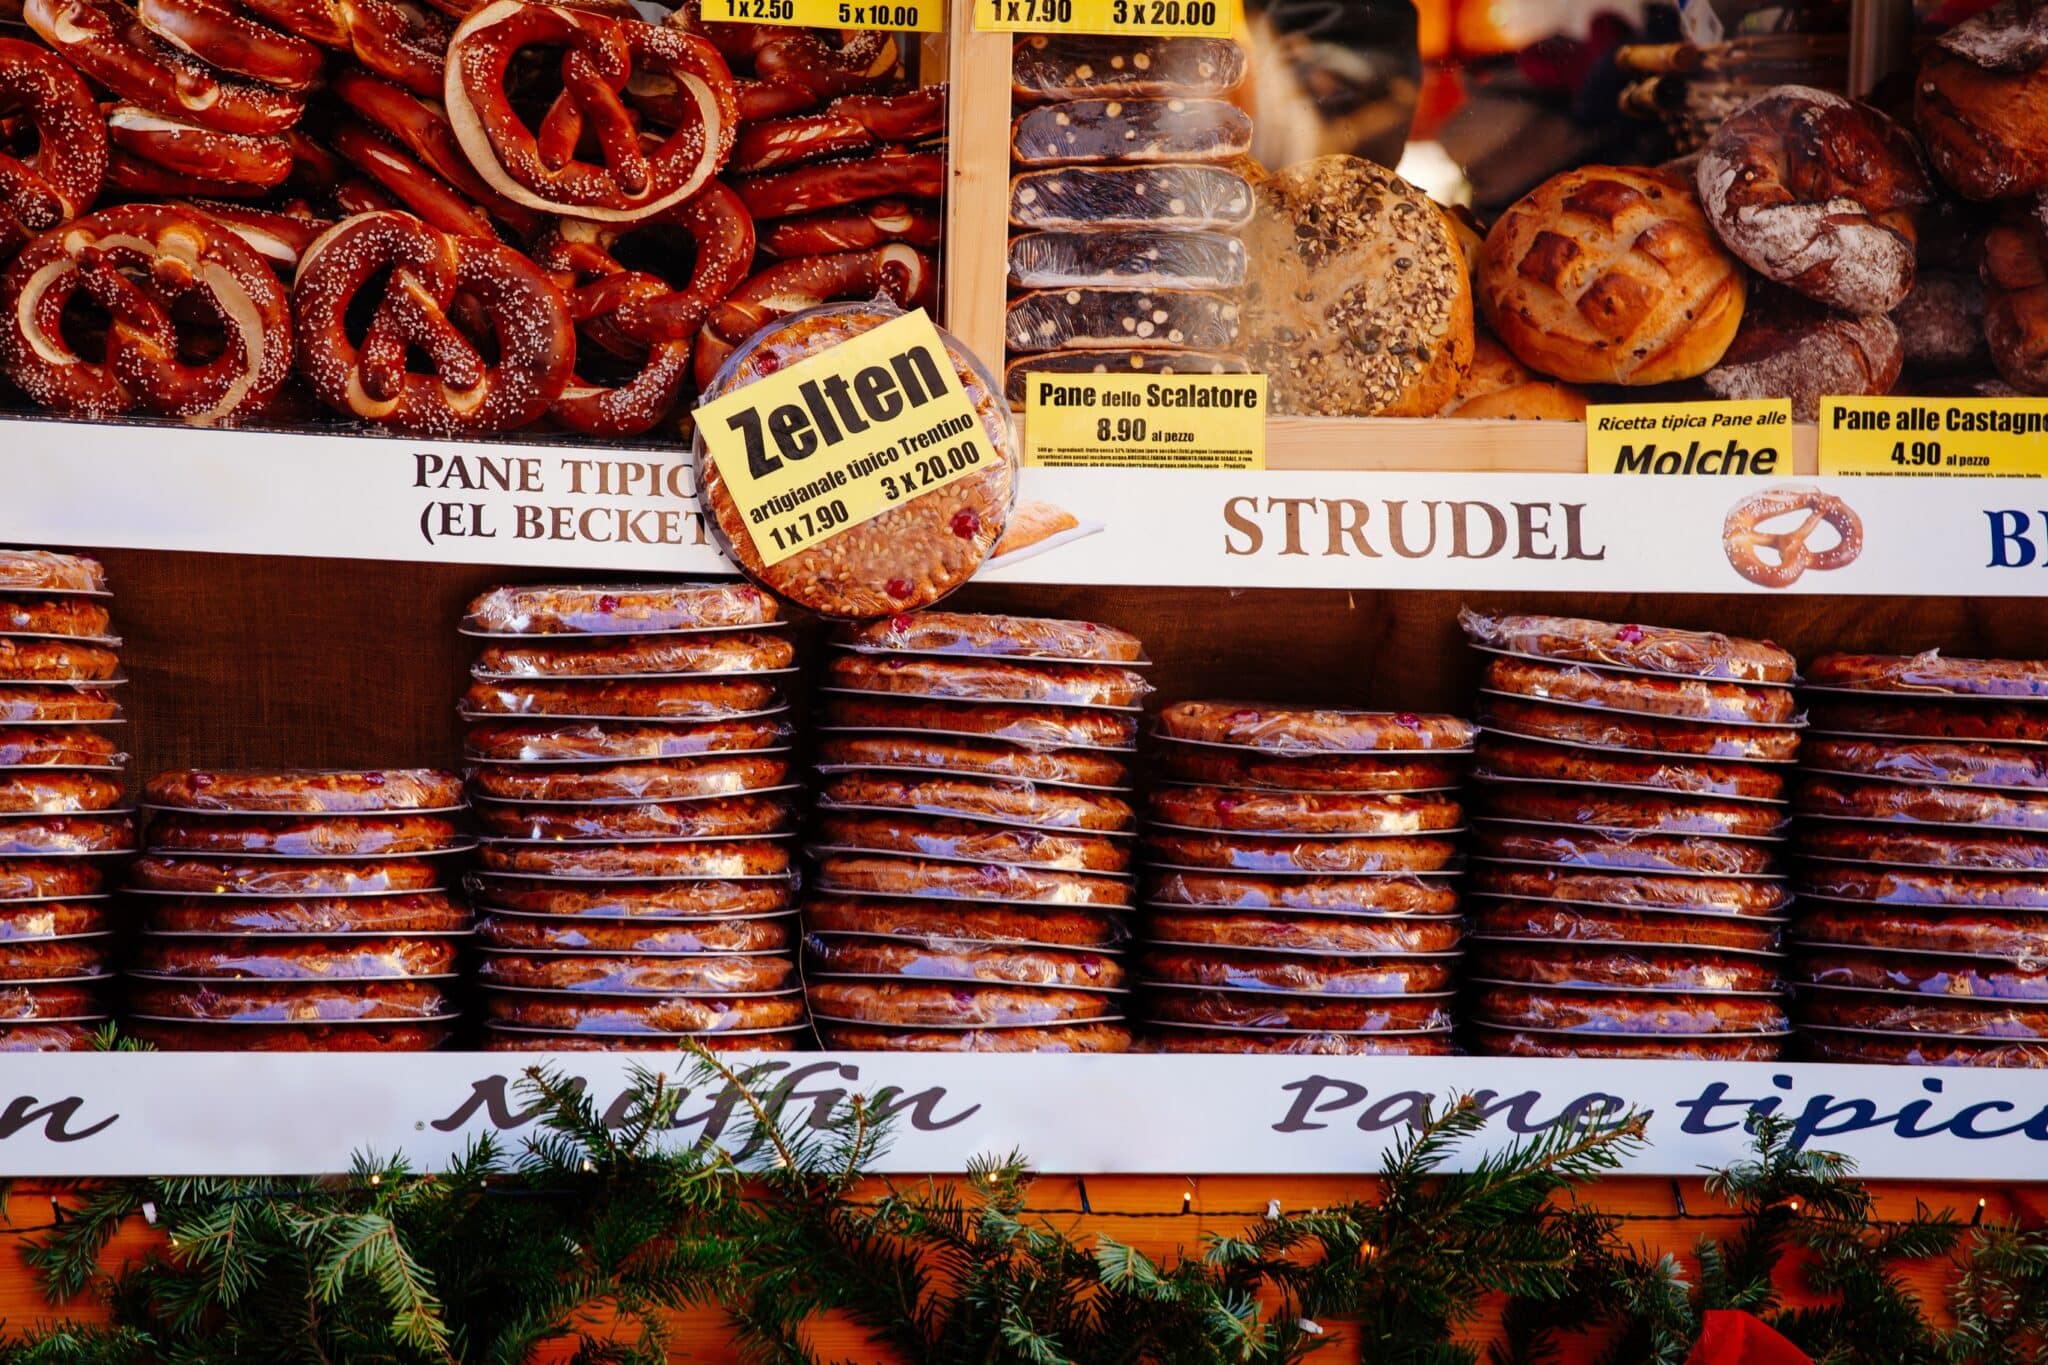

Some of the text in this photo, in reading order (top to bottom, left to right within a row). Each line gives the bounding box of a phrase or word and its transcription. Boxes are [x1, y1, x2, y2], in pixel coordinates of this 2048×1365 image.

[753, 0, 793, 20] 2.50
[839, 3, 850, 23] 5
[869, 5, 918, 26] 10.00
[1026, 0, 1071, 23] 7.90
[1113, 0, 1127, 24] 3
[1150, 0, 1216, 26] 20.00
[725, 345, 949, 480] Zelten
[1040, 383, 1257, 408] Pane dello Scalatore
[1097, 418, 1195, 443] 8.90 al pezzo
[1598, 411, 1786, 431] Ricetta tipica Pane alle
[1833, 407, 1890, 430] Pane
[1896, 408, 1940, 431] alle
[413, 453, 544, 491] PANE
[750, 413, 974, 524] artigianale tipico Trentino
[880, 475, 900, 500] 3
[915, 440, 981, 485] 20.00
[1613, 440, 1778, 475] Molche
[1891, 442, 1990, 467] 4.90 al pezzo
[420, 501, 722, 555] (EL BECKET
[769, 528, 785, 550] 1
[799, 499, 850, 538] 7.90
[1224, 496, 1606, 560] STRUDEL
[1983, 510, 2048, 568] B
[1271, 1075, 1655, 1133] Pane
